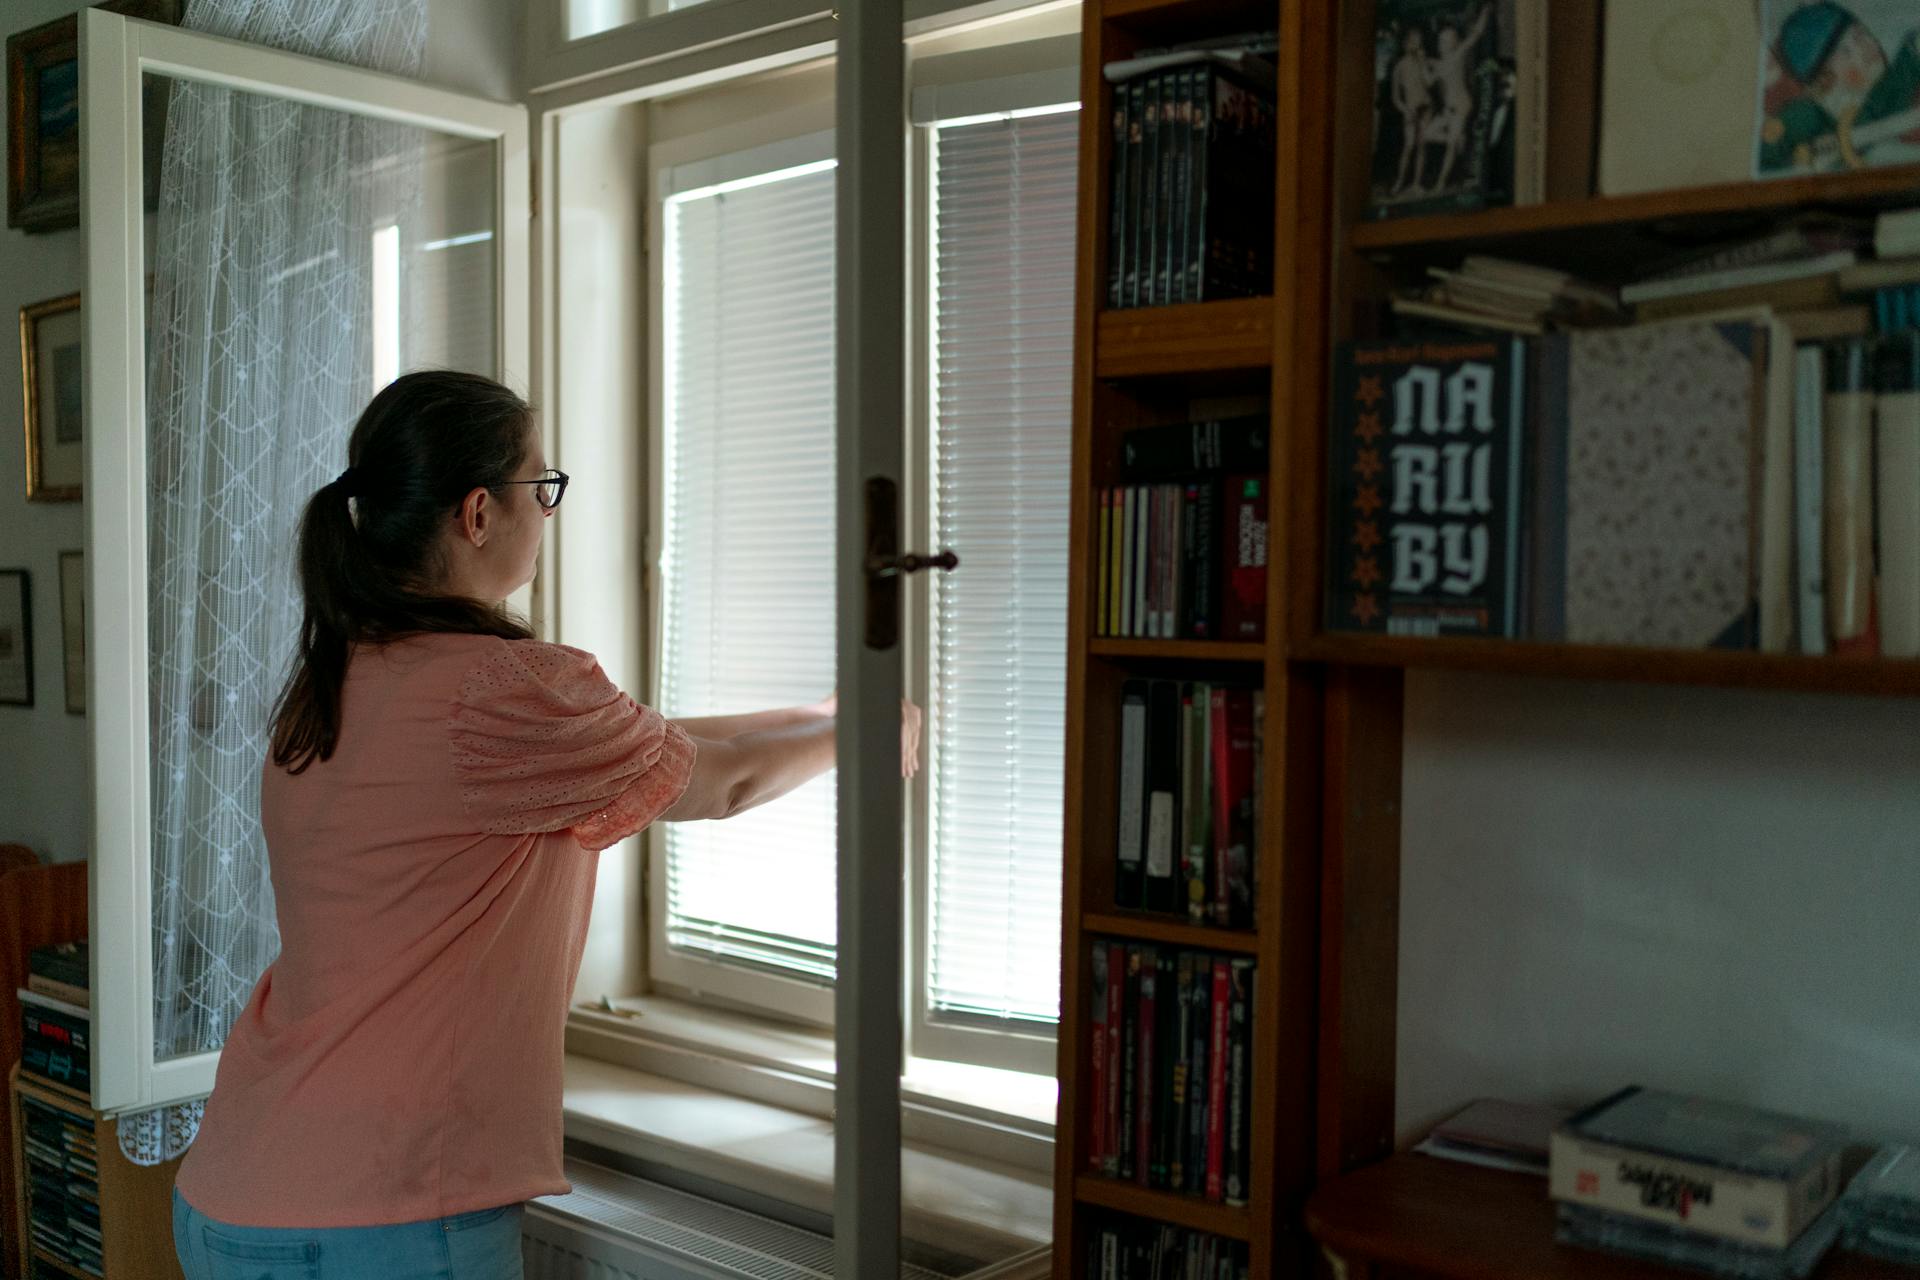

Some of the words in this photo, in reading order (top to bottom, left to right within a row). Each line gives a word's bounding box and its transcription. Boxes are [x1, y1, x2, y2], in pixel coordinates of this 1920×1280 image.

[1392, 361, 1495, 436] NA
[1389, 440, 1494, 516] RU
[1389, 521, 1490, 596] BY
